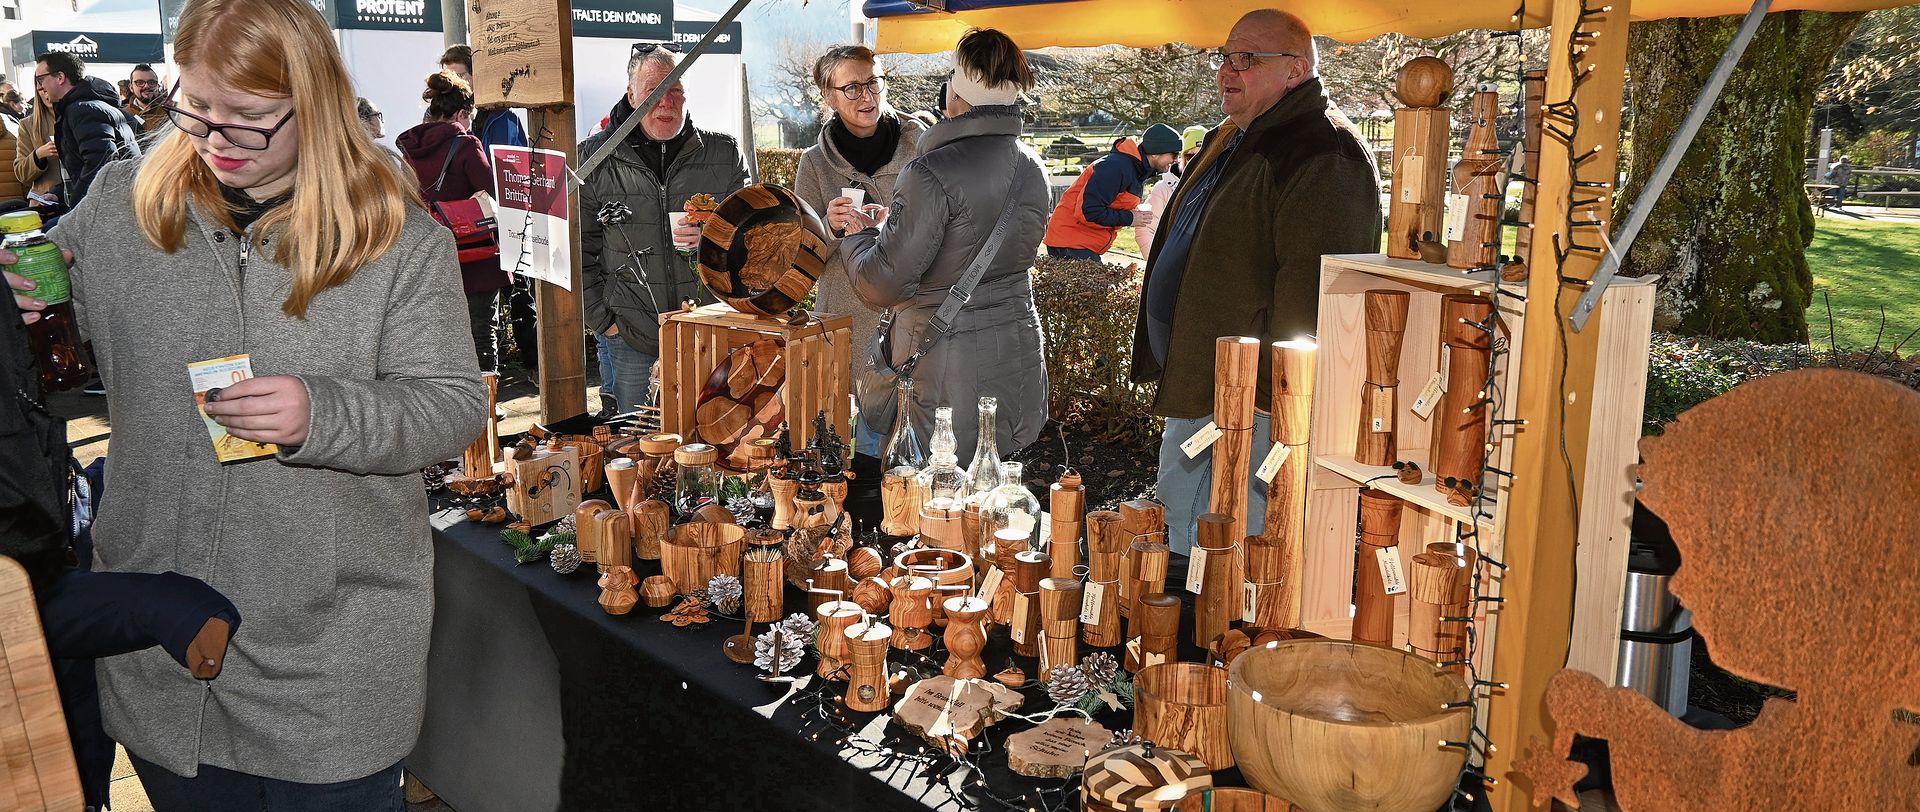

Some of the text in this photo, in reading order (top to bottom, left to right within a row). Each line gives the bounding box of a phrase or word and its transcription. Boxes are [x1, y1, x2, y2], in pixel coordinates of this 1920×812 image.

[356, 0, 425, 16] PROTENT
[573, 9, 662, 25] TFALTE DEIN KÖNNEN
[47, 42, 98, 54] PROTENT
[924, 688, 934, 696] Im
